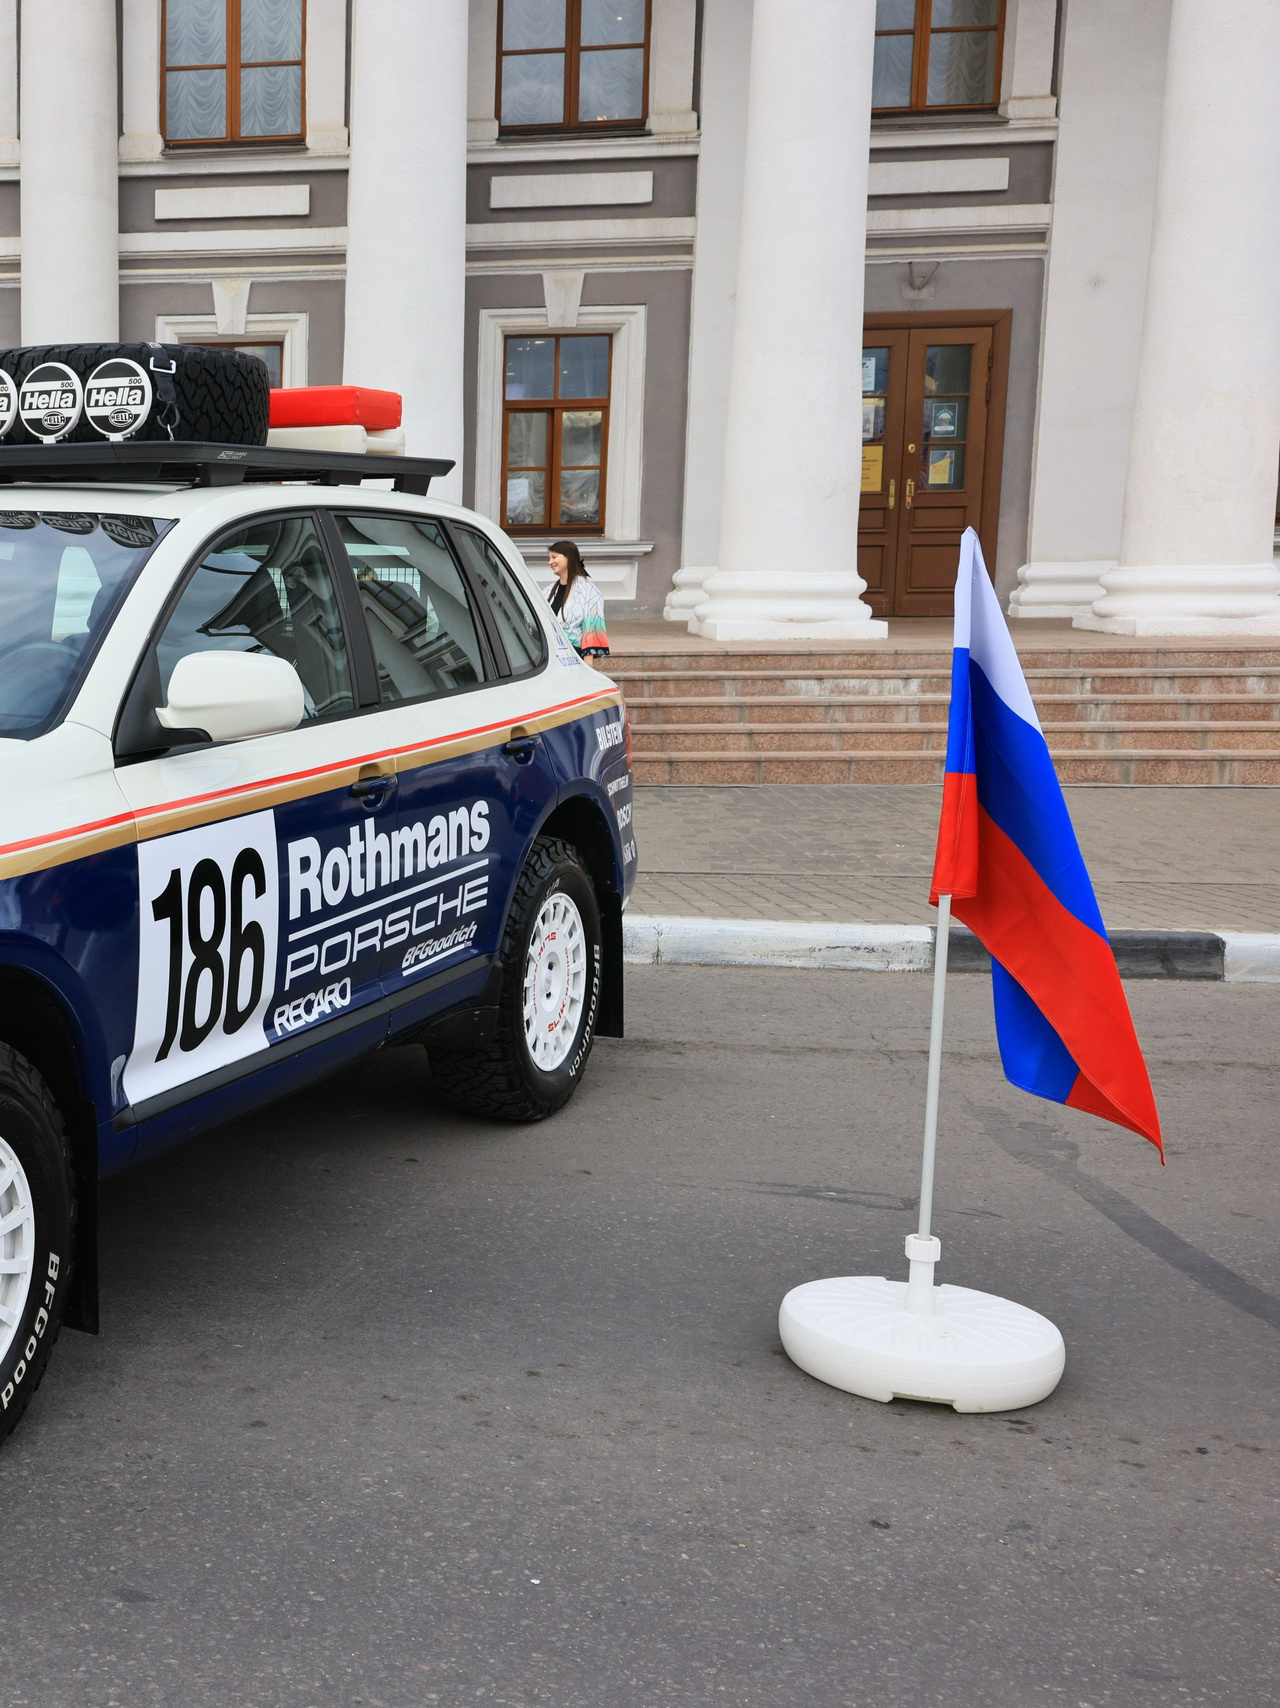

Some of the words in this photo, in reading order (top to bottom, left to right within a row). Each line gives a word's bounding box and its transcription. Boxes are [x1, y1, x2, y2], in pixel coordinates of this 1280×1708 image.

[23, 391, 74, 409] Hella
[44, 415, 65, 425] HELLA
[89, 387, 142, 407] Hella
[110, 412, 133, 422] HELLA
[595, 721, 624, 751] BILSTEIN
[288, 799, 491, 921] Rothmans
[151, 847, 267, 1063] 186
[284, 874, 489, 991] PORSCHE
[402, 921, 478, 968] BFGoodrich
[274, 977, 352, 1037] RECARO
[568, 943, 600, 1078] BFGoodrich
